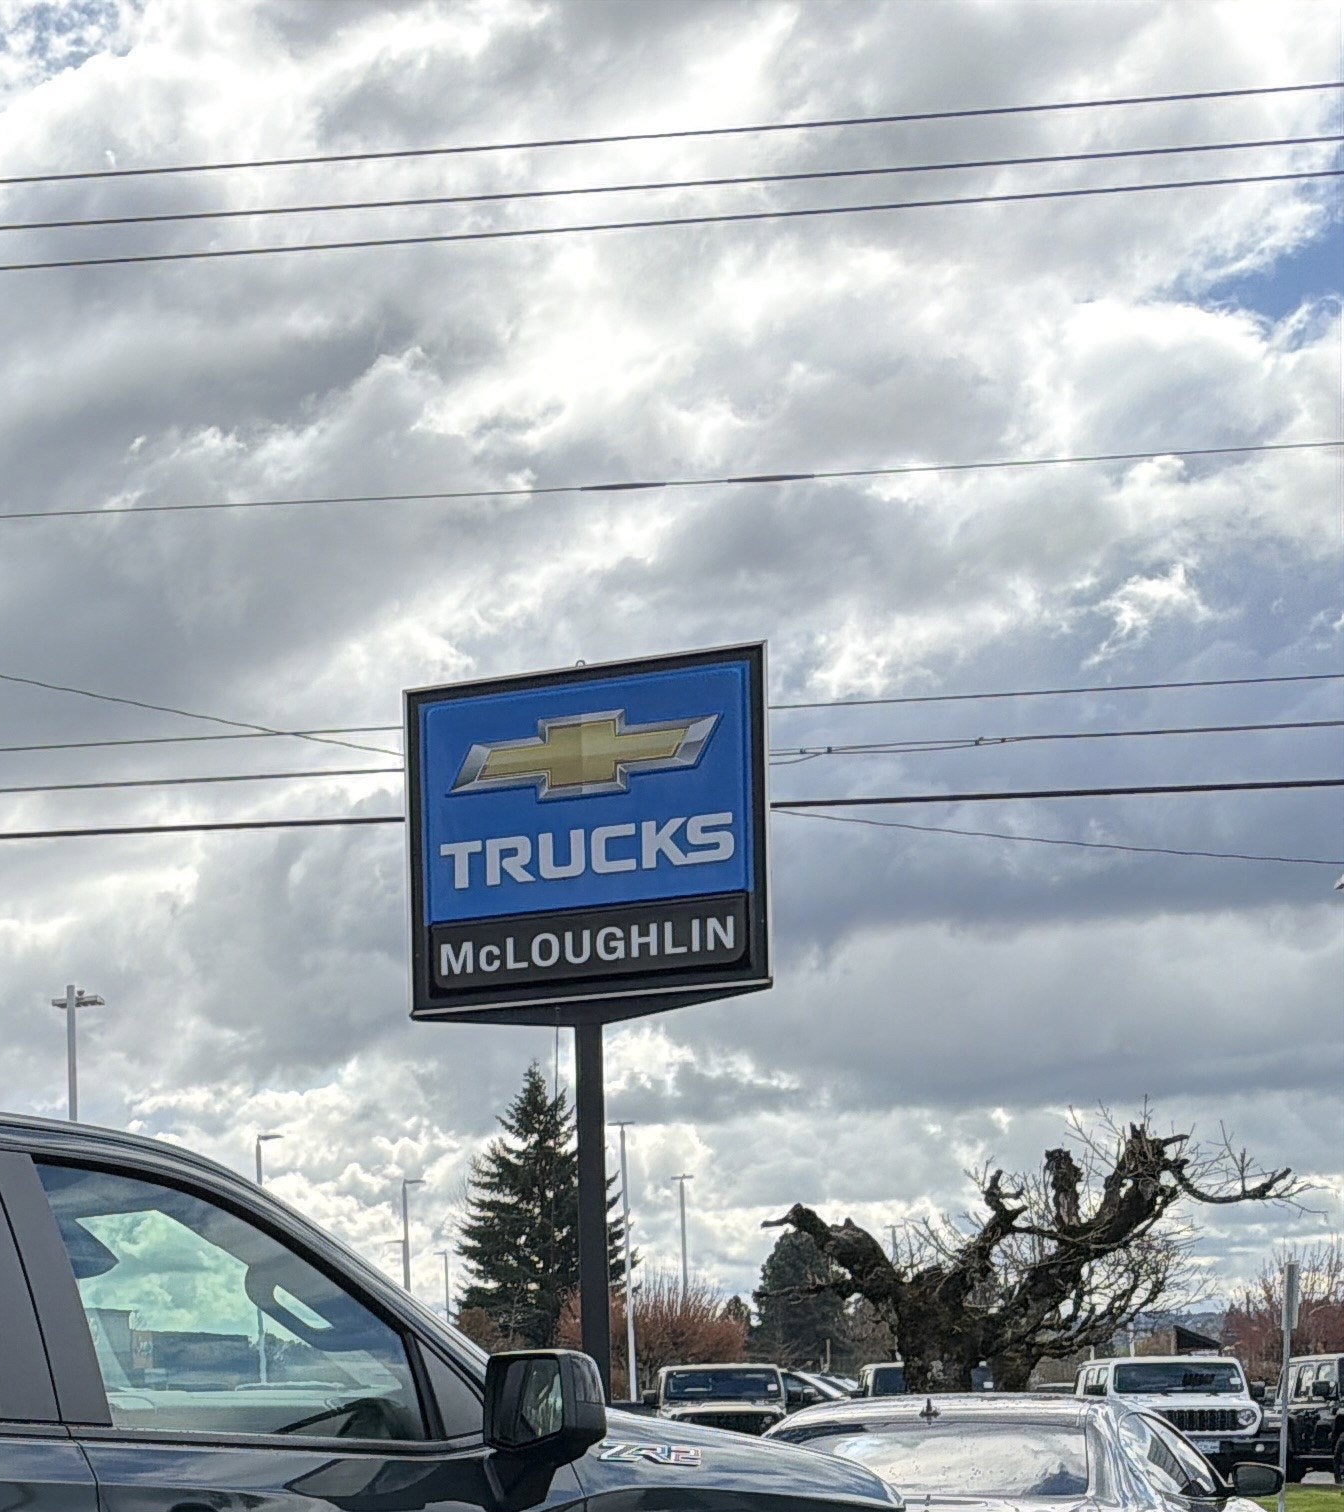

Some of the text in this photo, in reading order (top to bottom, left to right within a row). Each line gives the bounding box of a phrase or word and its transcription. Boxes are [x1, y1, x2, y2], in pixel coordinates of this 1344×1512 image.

[439, 811, 735, 890] TRUCKS
[439, 914, 735, 977] McLOUGHLIN
[598, 1440, 702, 1466] ZR2
